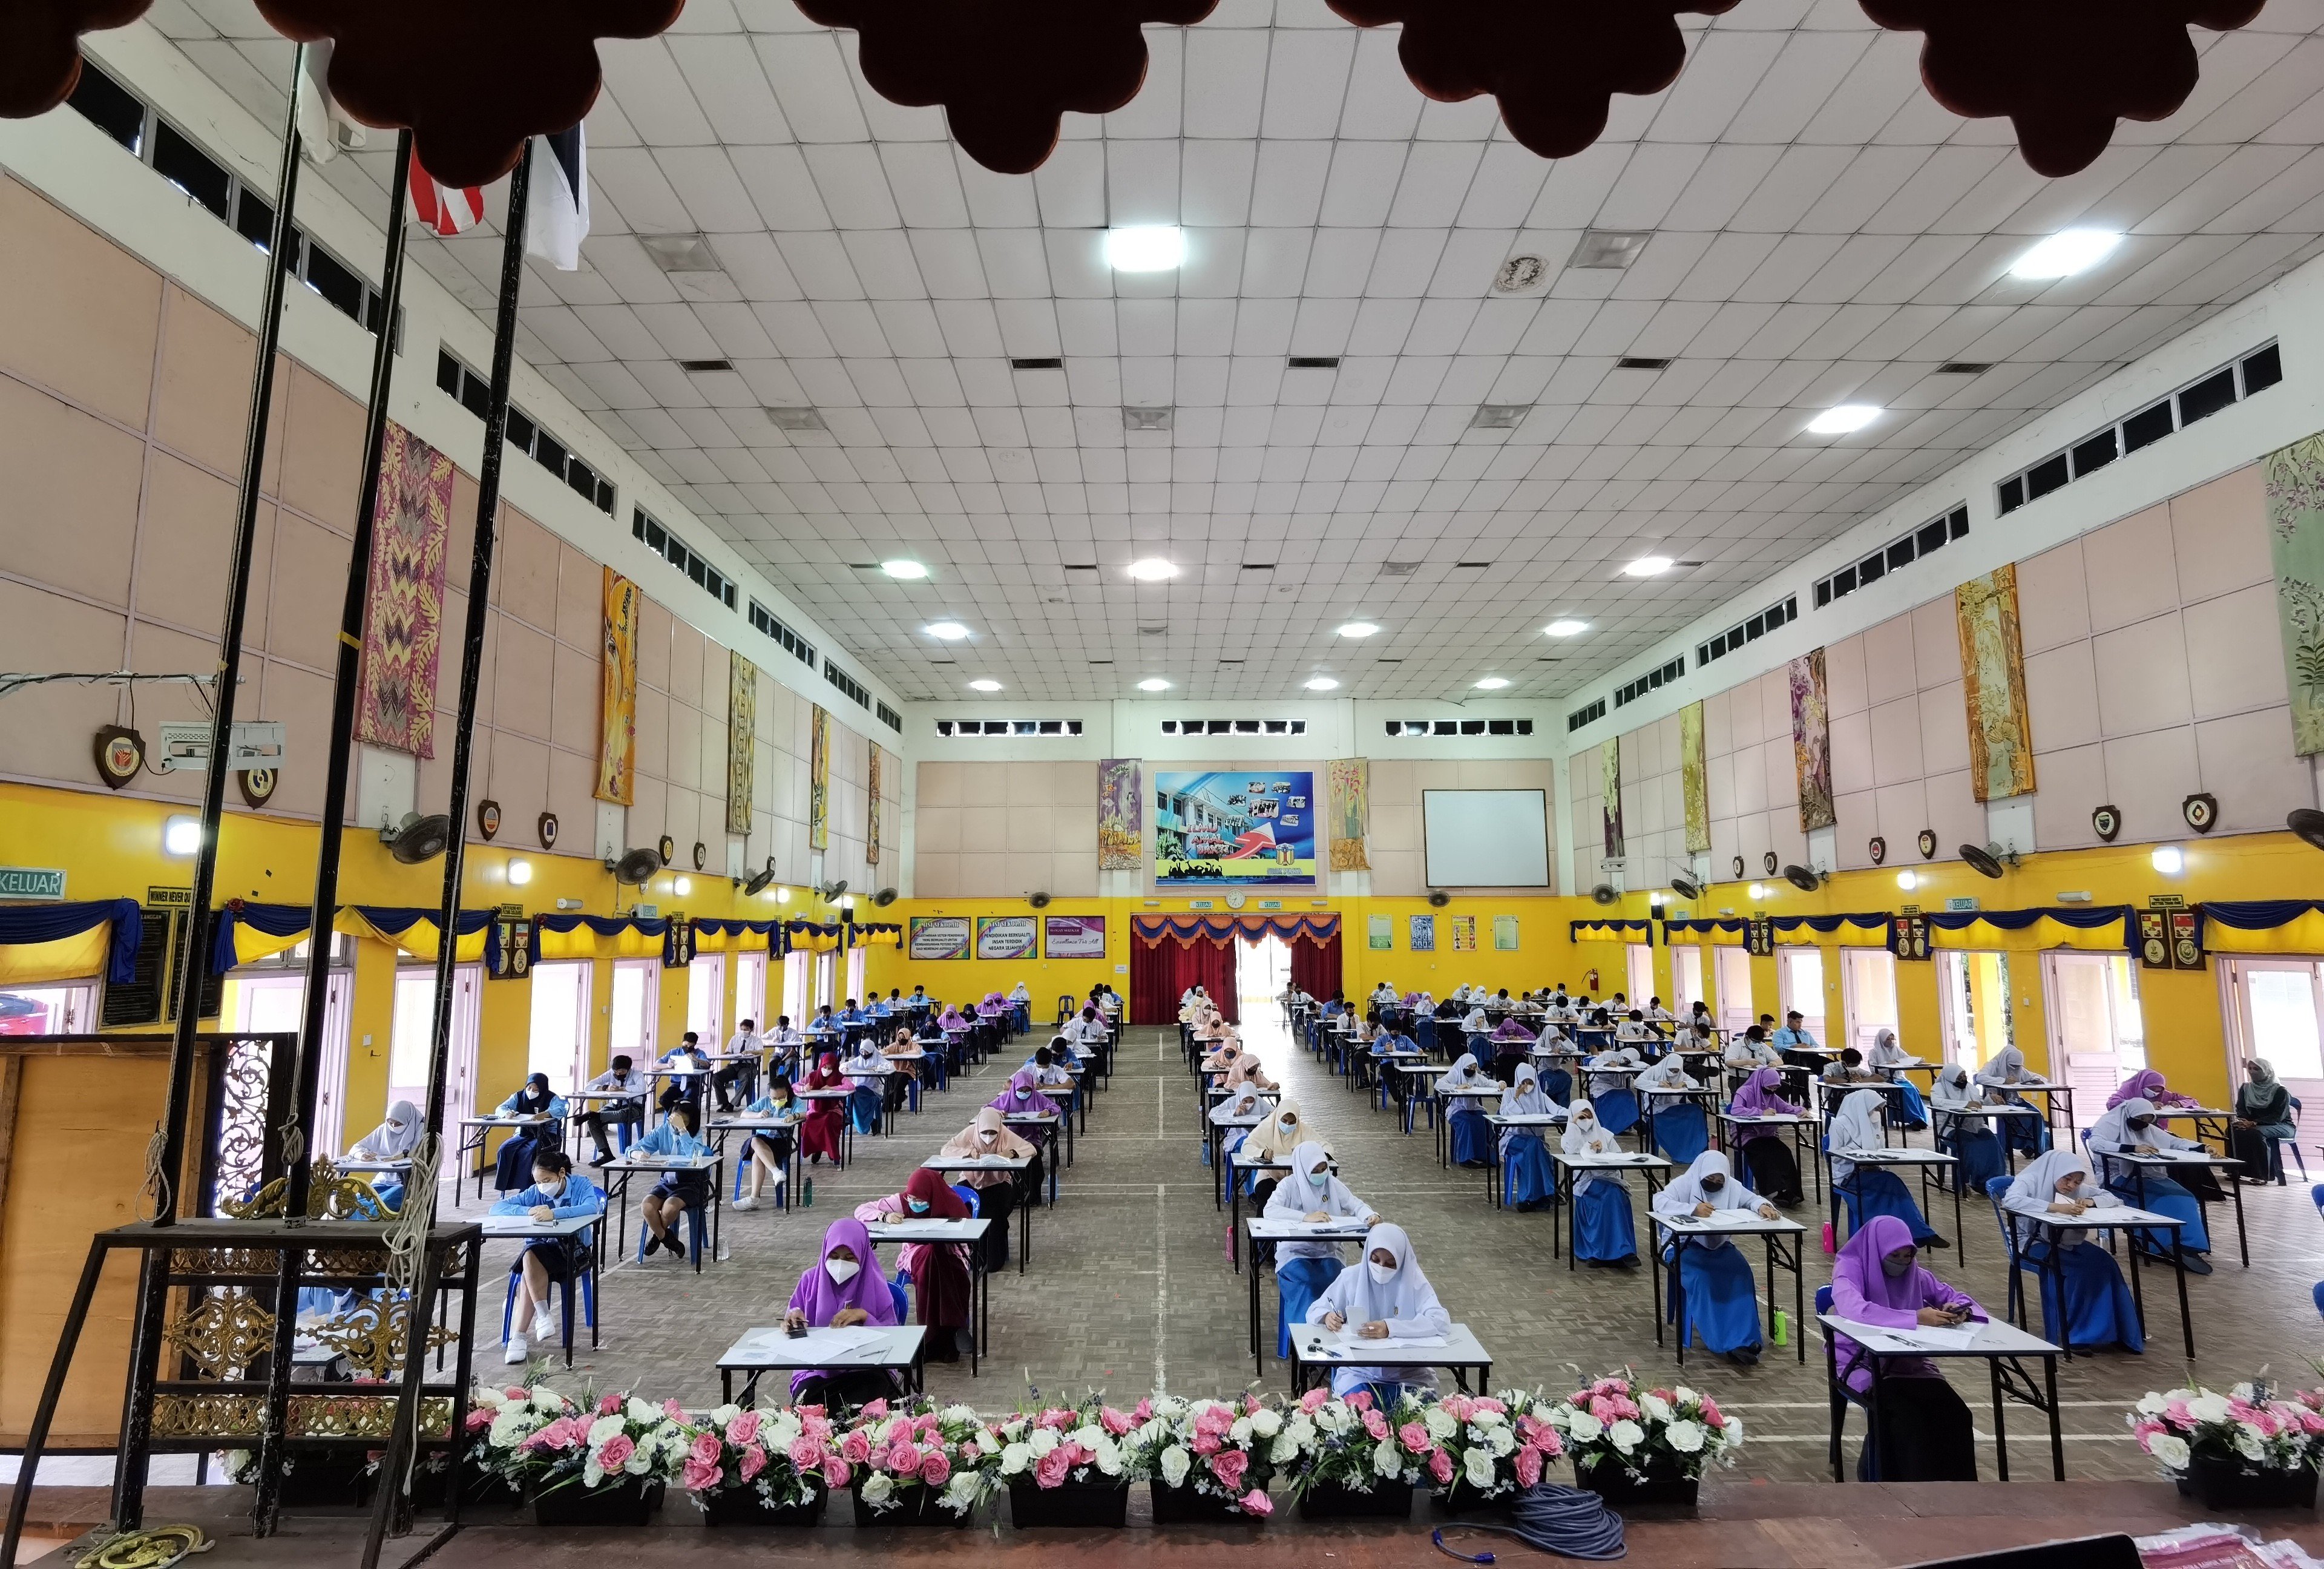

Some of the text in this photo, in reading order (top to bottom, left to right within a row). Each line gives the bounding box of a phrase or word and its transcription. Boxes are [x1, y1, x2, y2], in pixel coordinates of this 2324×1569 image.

[1187, 823, 1218, 833] ILMU
[1192, 834, 1224, 844] AMAL
[0, 873, 61, 893] KELUAR
[1953, 900, 1972, 909] KELUAR
